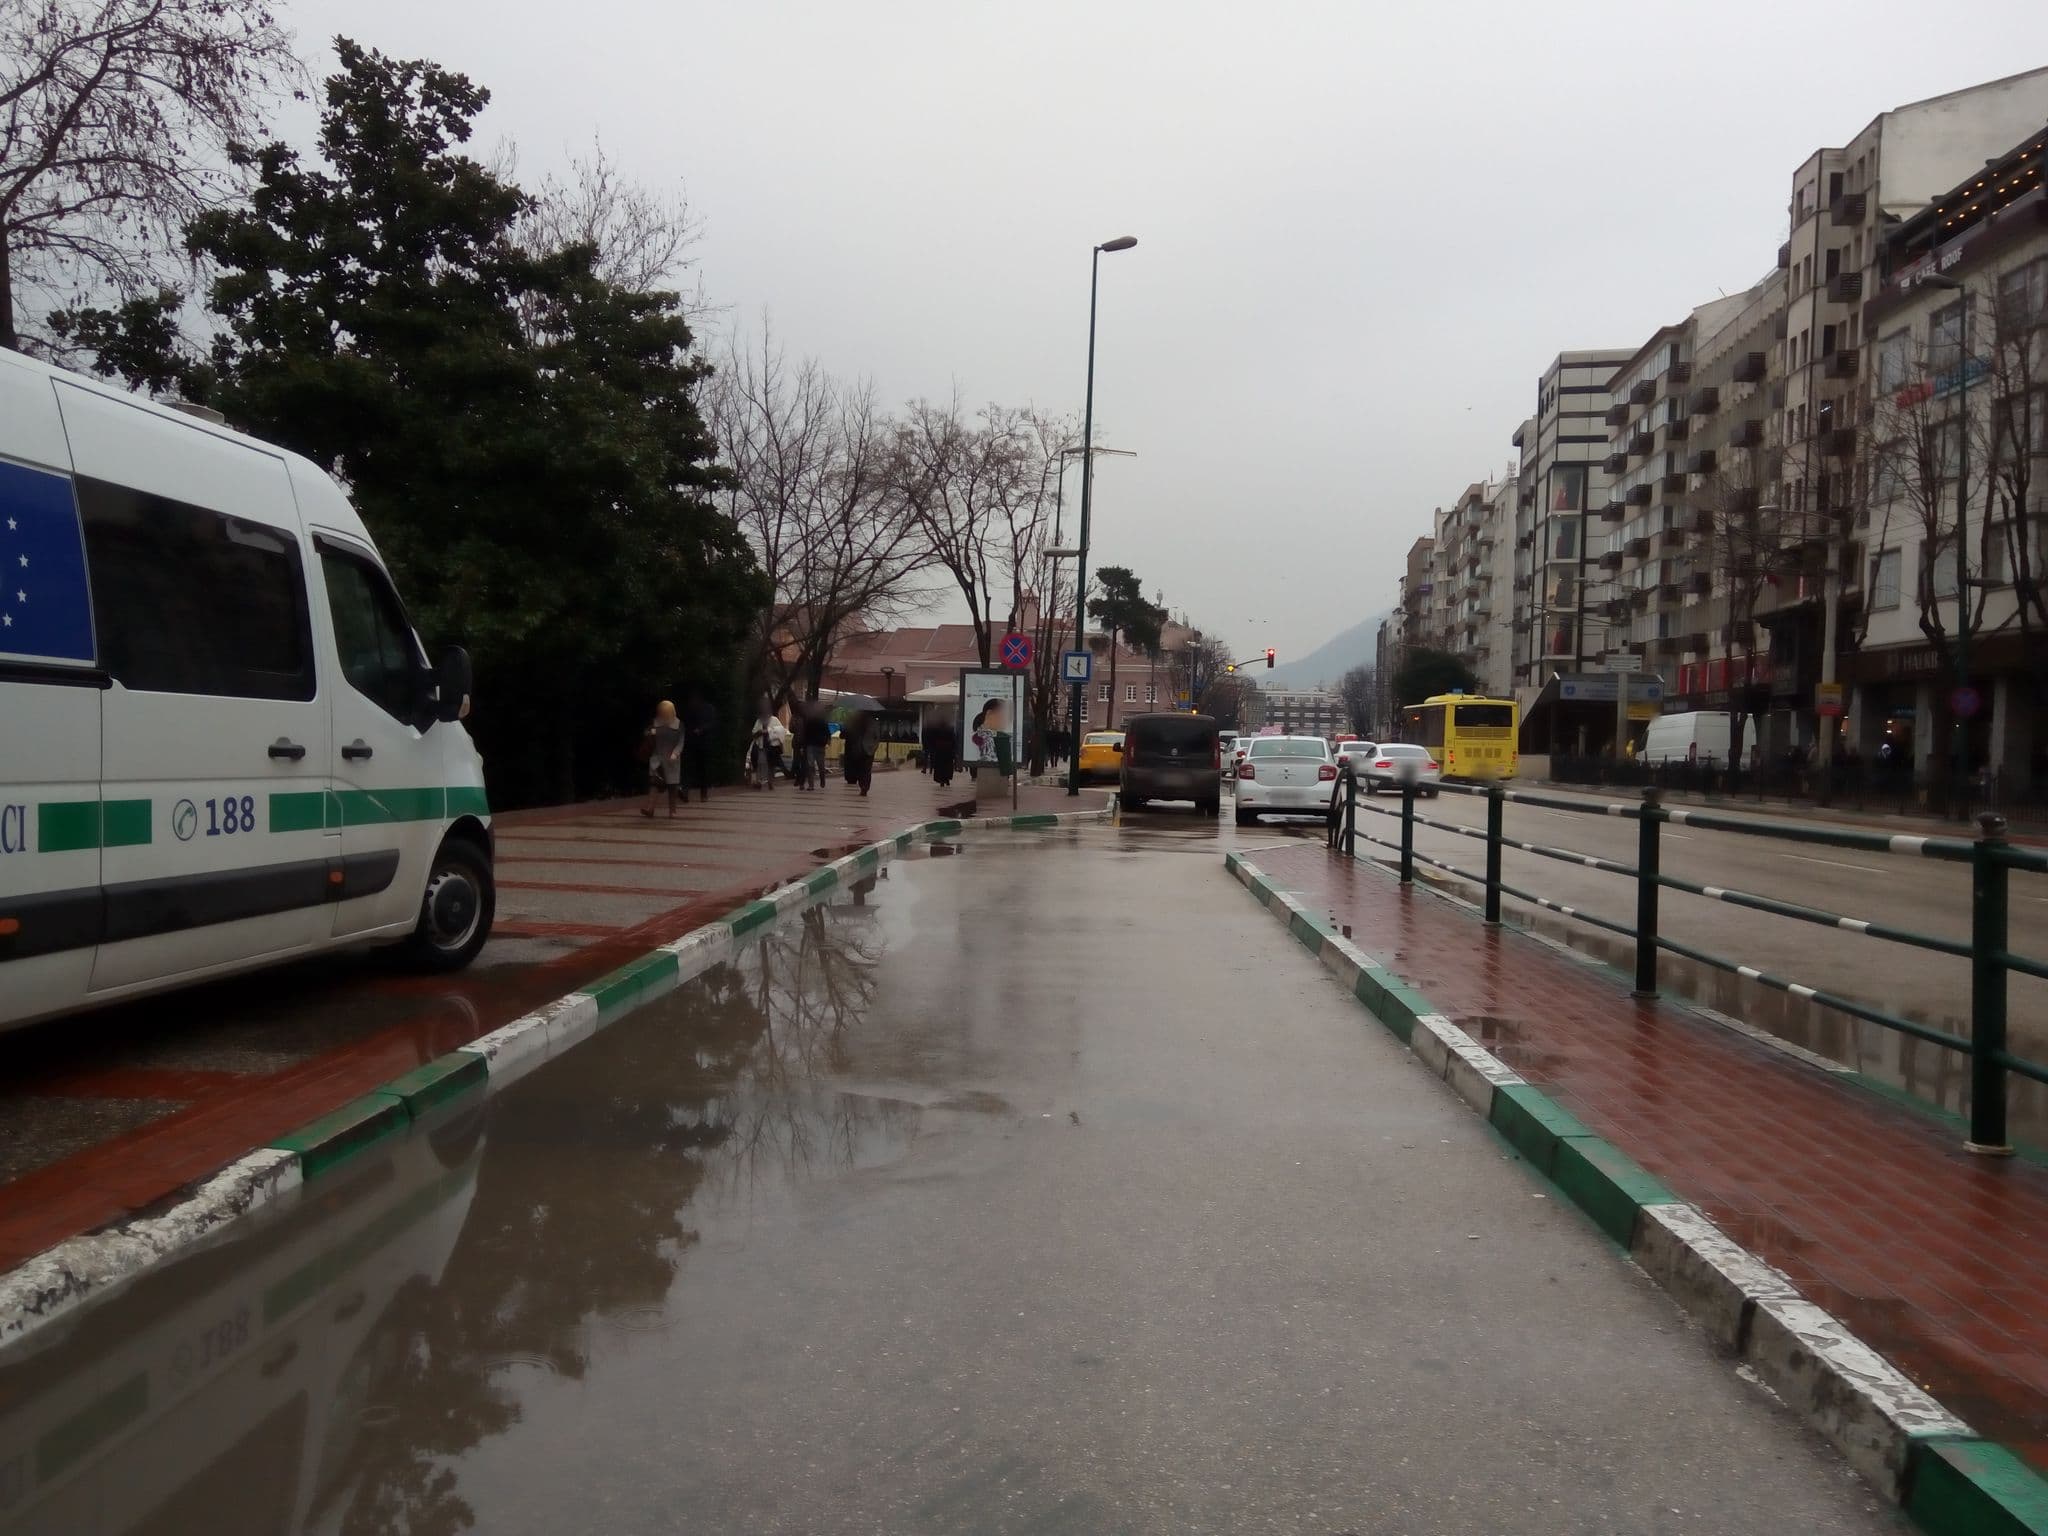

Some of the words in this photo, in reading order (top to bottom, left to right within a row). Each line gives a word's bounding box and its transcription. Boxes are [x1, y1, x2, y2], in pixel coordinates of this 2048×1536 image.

[1941, 247, 1963, 271] ROOF
[0, 804, 26, 854] CI
[205, 795, 256, 836] 188
